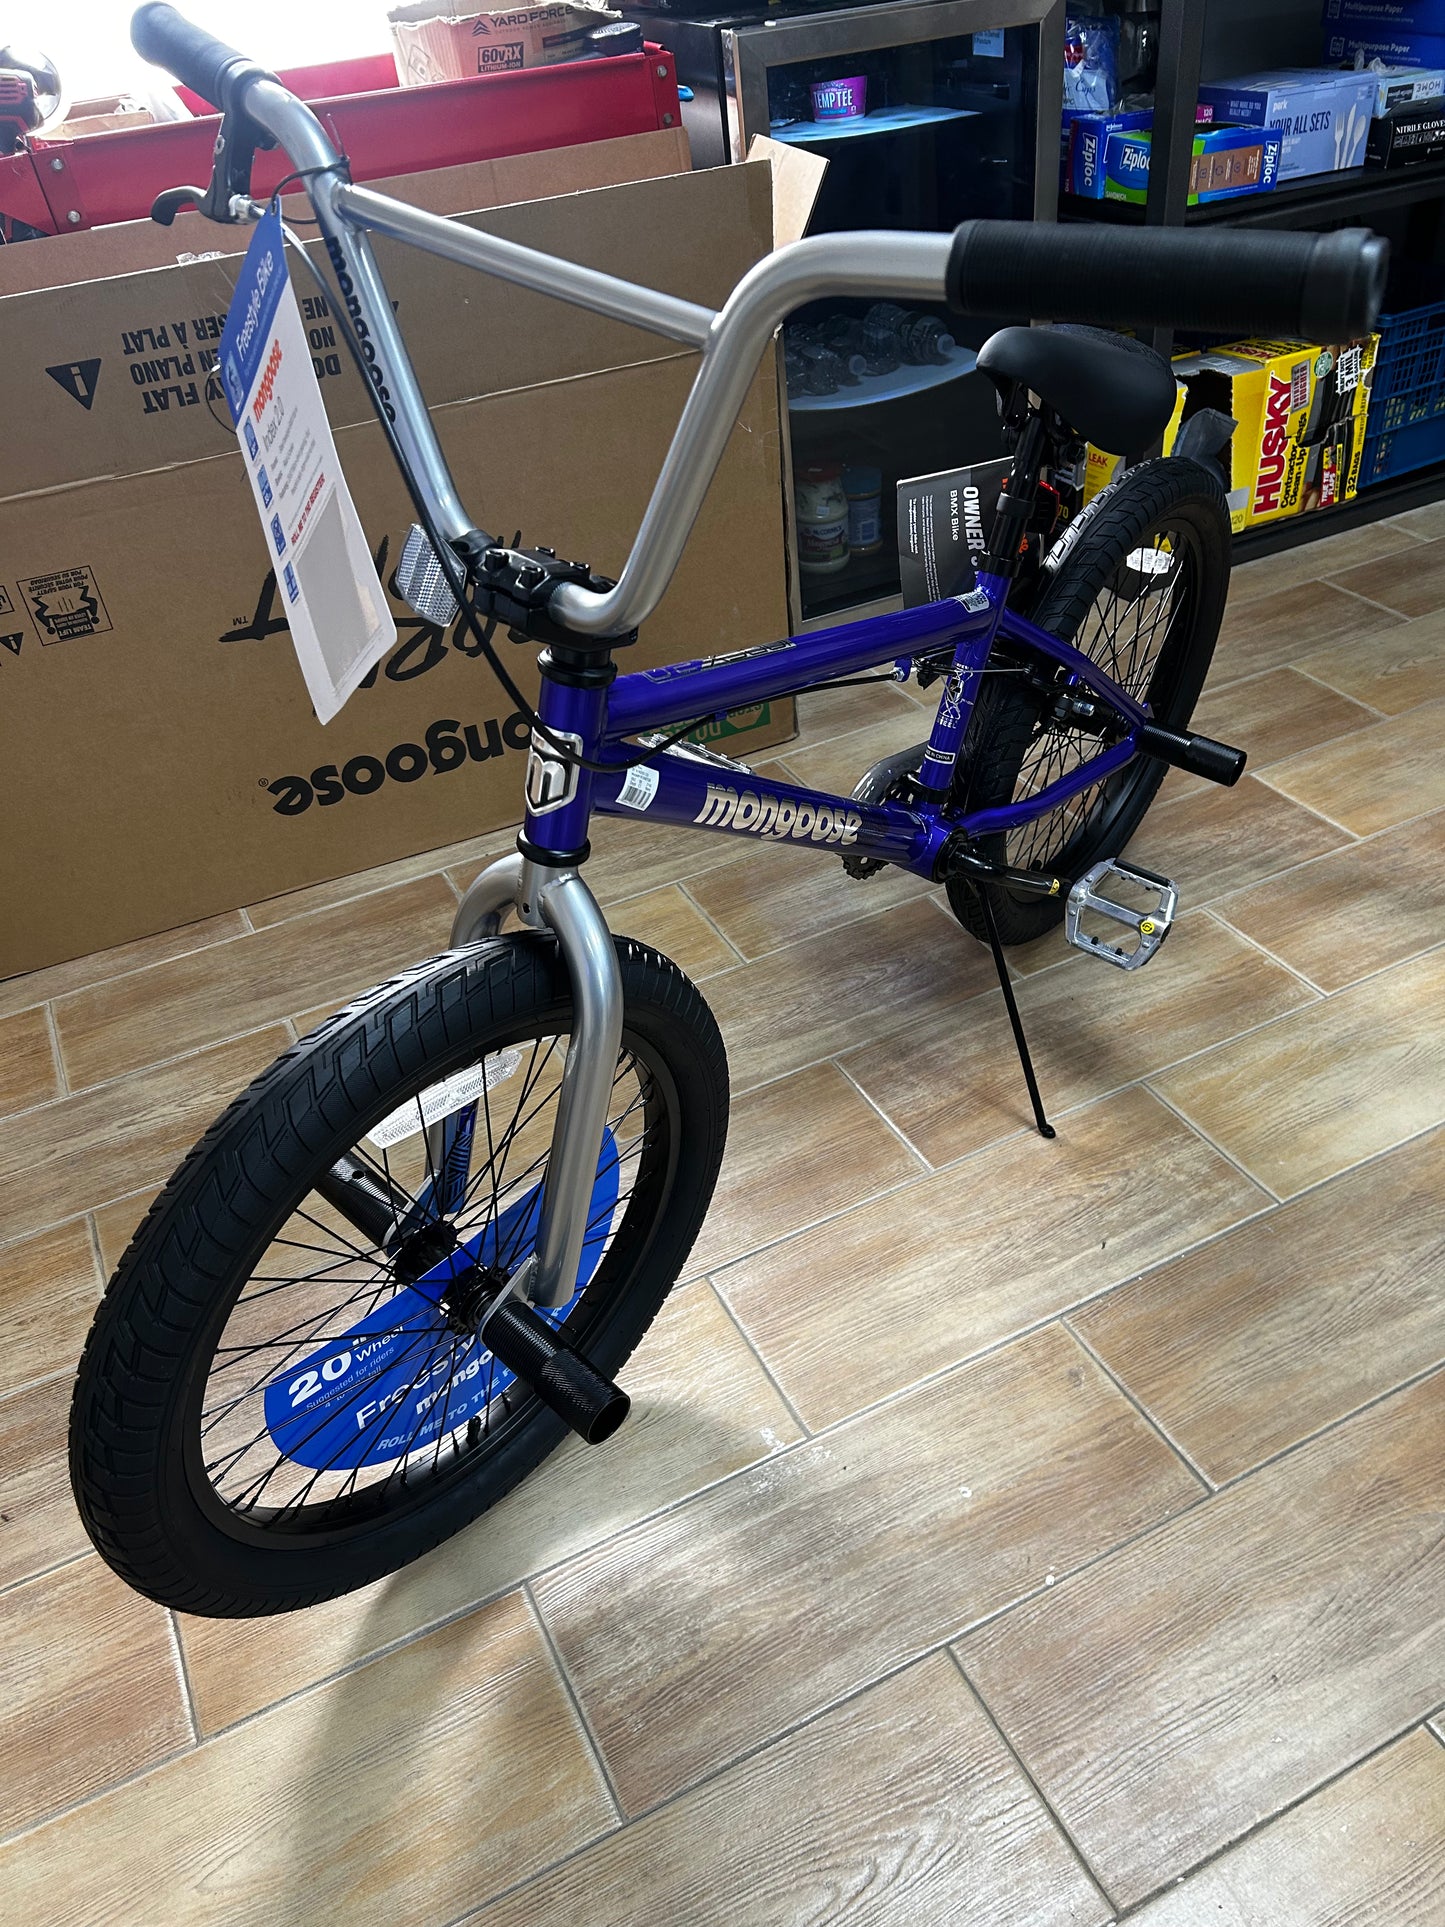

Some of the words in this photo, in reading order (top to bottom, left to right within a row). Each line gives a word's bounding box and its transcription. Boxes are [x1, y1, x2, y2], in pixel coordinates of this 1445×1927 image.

[490, 14, 528, 27] YARD
[529, 5, 574, 22] FORCE
[1390, 43, 1411, 54] Paper
[1293, 114, 1308, 135] ALL
[1309, 110, 1331, 132] SETS
[1396, 122, 1422, 135] NITRILE
[1422, 119, 1445, 131] GLOVE
[1081, 137, 1096, 187] Ziploc
[1263, 143, 1278, 184] Ziploc
[235, 292, 263, 362] Freestyle
[257, 250, 274, 295] Bike
[121, 325, 171, 356] PLAT
[191, 313, 228, 341] SER
[309, 325, 336, 349] NO
[129, 353, 196, 386] PLANO
[1345, 351, 1355, 375] MIL
[252, 338, 283, 424] mongoose
[1345, 378, 1355, 388] 3
[141, 382, 200, 415] FLAT
[1253, 375, 1292, 514] HUSKY
[1088, 452, 1108, 467] LEAK
[1351, 451, 1362, 477] BAGS
[1280, 443, 1299, 512] Contractor
[1346, 477, 1357, 493] 32
[950, 489, 959, 516] BMX
[951, 517, 960, 541] Bike
[58, 628, 73, 637] LIFT
[72, 623, 92, 633] TEAM
[266, 711, 532, 816] ongoose
[936, 753, 951, 761] CHINA
[694, 782, 864, 846] mongoose
[306, 1375, 354, 1409] Suggested
[355, 1366, 368, 1378] for
[369, 1347, 395, 1368] riders
[376, 1431, 414, 1451] ROLL
[420, 1418, 444, 1436] ME
[449, 1403, 468, 1420] TO
[471, 1376, 501, 1403] THE
